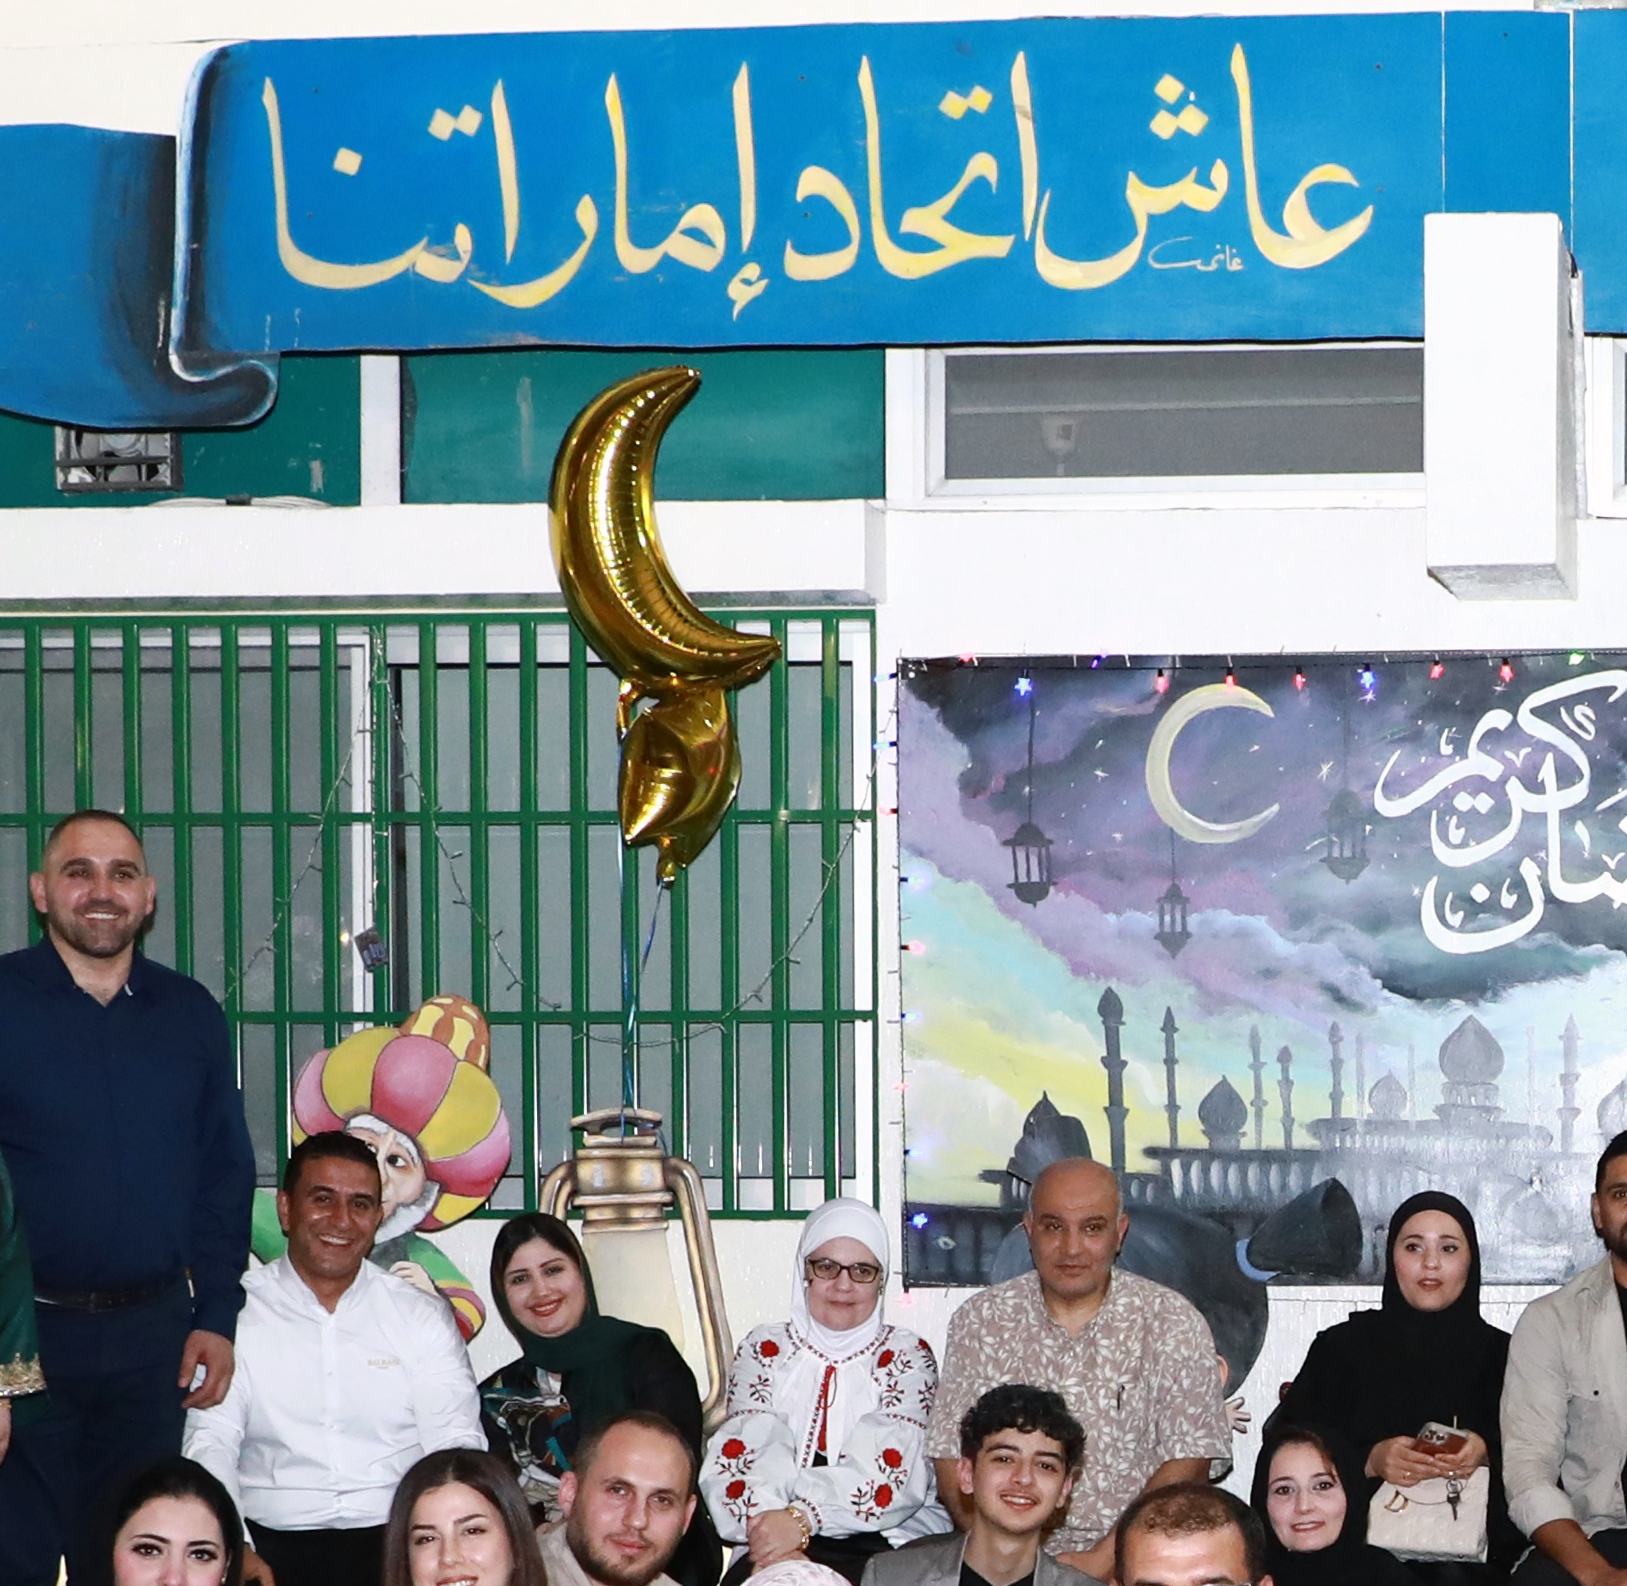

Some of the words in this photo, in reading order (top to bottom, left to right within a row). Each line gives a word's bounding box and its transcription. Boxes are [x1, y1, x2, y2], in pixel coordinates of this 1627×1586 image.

[262, 63, 769, 320] إماراتنا
[784, 50, 1039, 281] اتحاد
[1035, 43, 1374, 290] عاش
